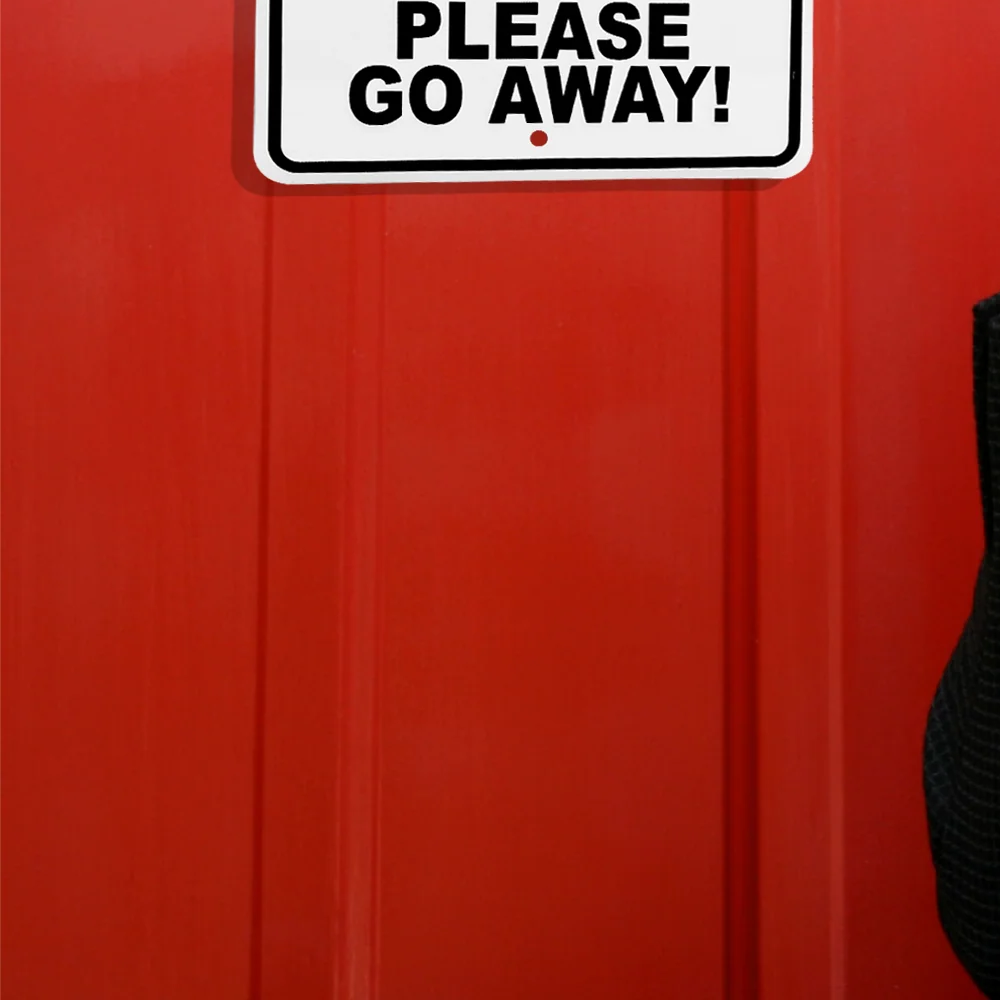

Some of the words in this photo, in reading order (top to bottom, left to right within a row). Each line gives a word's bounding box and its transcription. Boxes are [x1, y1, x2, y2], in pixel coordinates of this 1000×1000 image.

[396, 0, 690, 61] PLEASE
[348, 64, 463, 126] GO
[488, 65, 731, 125] AWAY!
